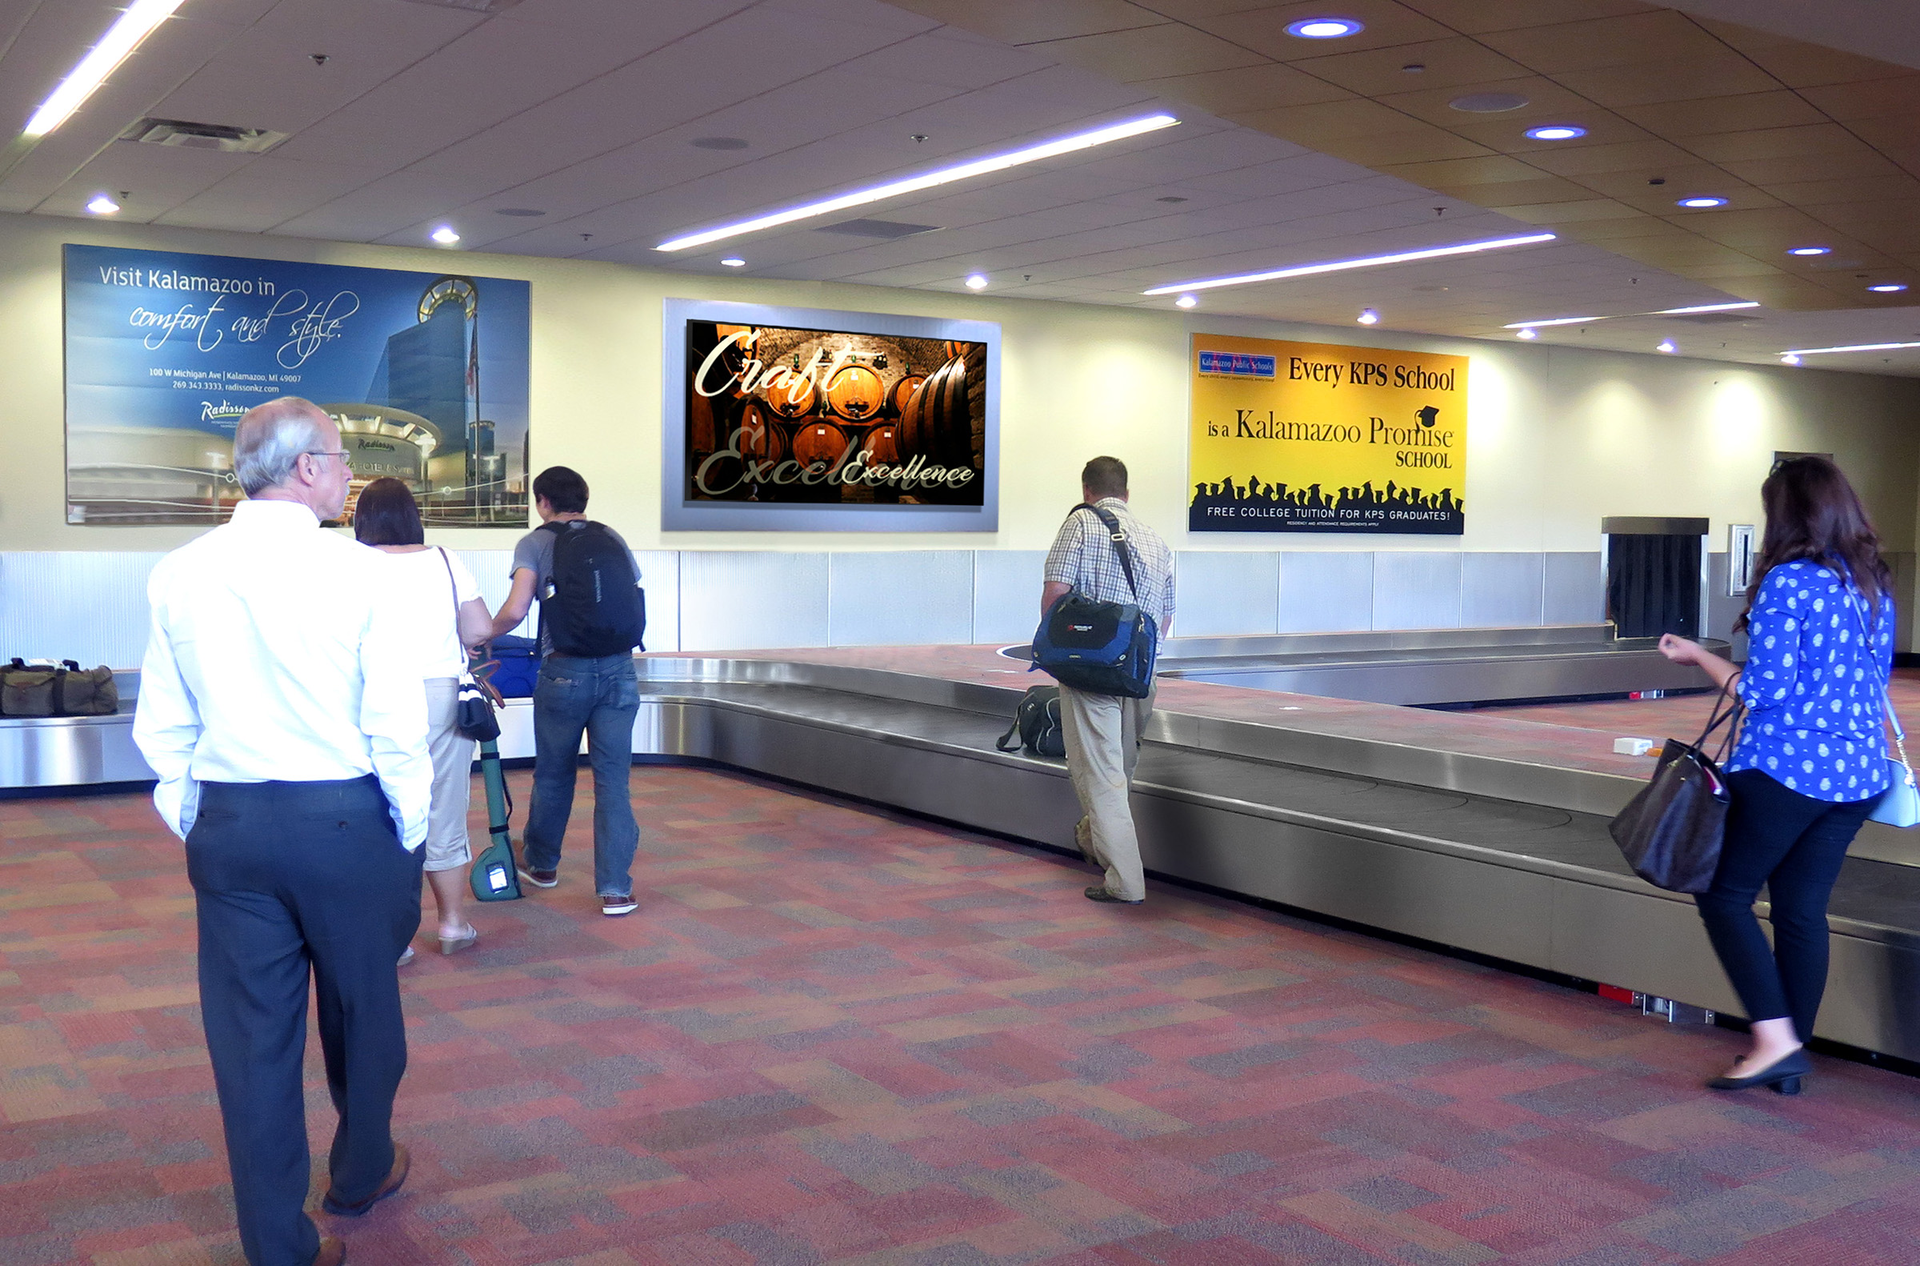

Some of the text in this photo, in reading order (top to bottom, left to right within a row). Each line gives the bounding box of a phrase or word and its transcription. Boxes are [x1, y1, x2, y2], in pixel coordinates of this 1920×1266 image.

[99, 266, 275, 296] Visit Kalamazoo in
[129, 289, 360, 369] comfort and style.
[149, 367, 163, 377] 100
[163, 368, 173, 378] W
[173, 369, 207, 380] Michigan
[208, 371, 222, 379] Ave
[279, 374, 302, 383] 49007
[694, 328, 884, 405] Craft
[1289, 357, 1455, 391] Every KPS School
[1207, 409, 1455, 448] is a Kalamazoo Promise
[841, 449, 975, 485] Excellence
[1395, 450, 1452, 469] SCHOOL
[1207, 507, 1450, 520] FREE COLLEGE TUITION FOR KPS GRADUATES!
